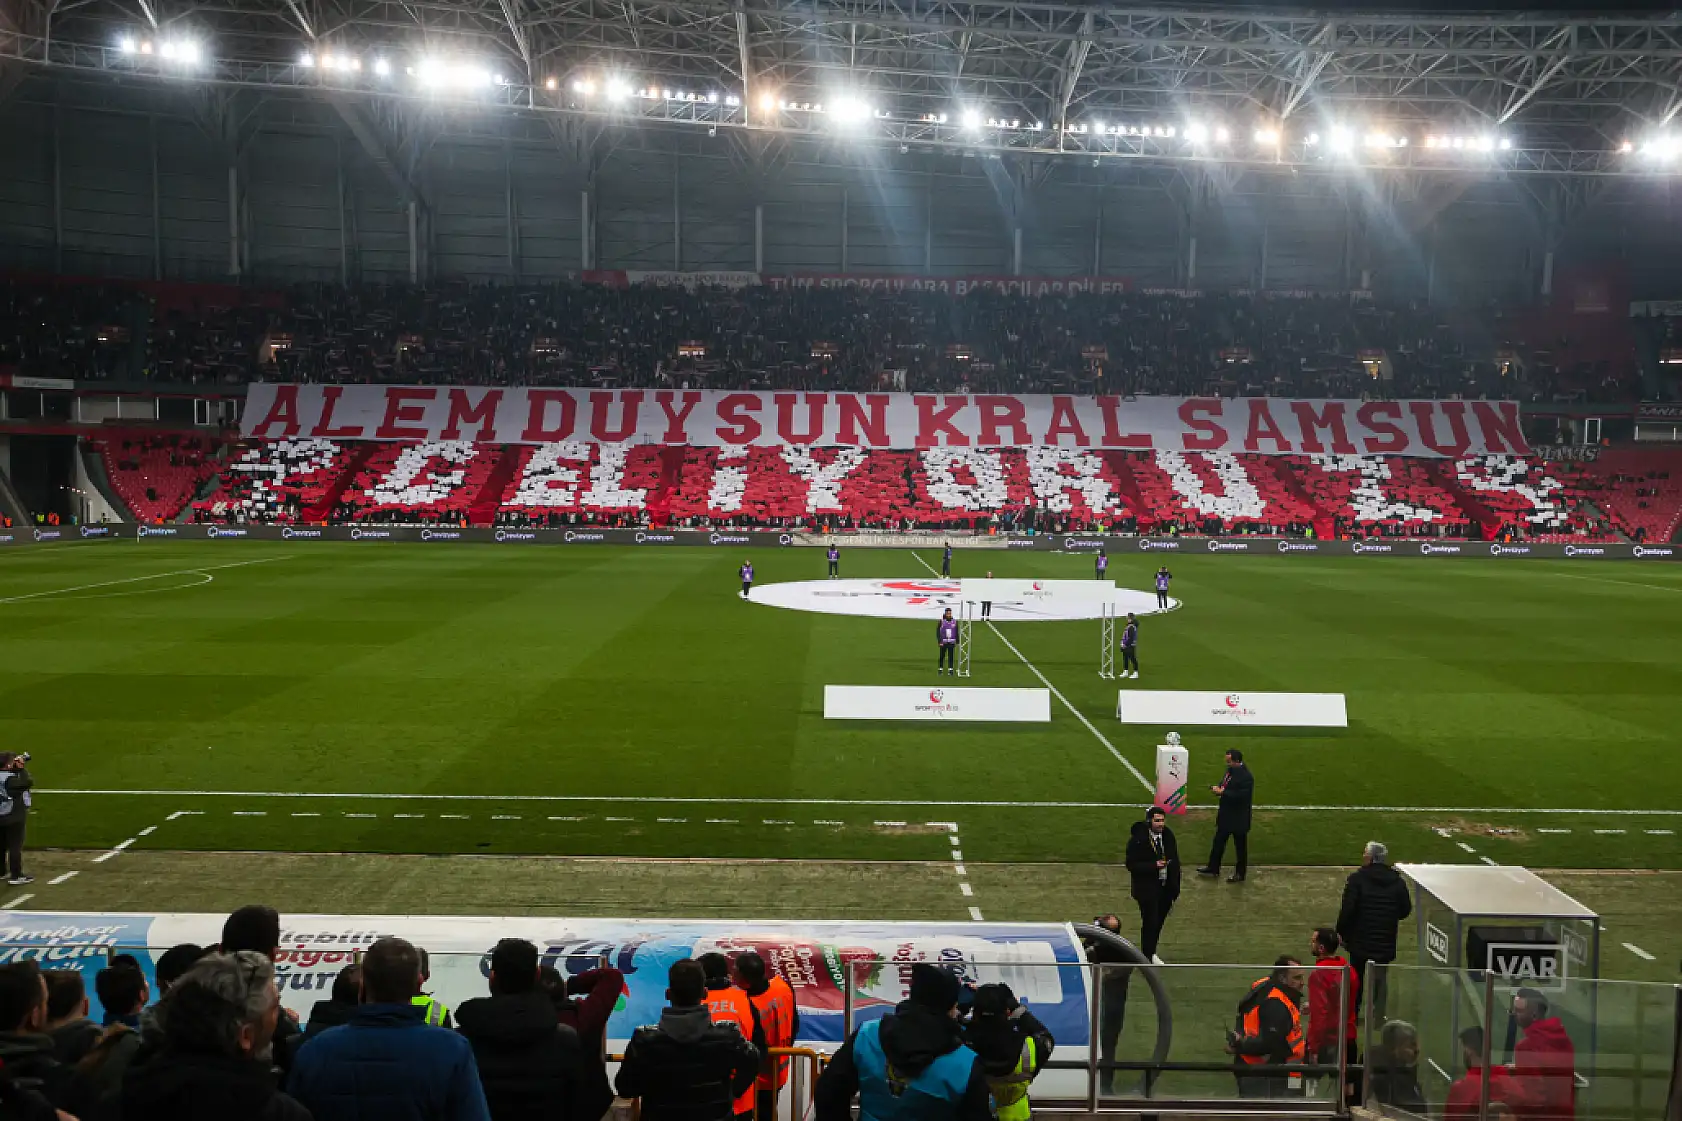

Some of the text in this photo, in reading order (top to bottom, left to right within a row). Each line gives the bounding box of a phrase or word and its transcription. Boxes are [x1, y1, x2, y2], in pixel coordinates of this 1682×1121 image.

[251, 385, 503, 441] ALEM
[914, 394, 1152, 446] KRAL
[1178, 399, 1534, 457] SAMSUN
[1429, 929, 1446, 952] VAR
[1497, 955, 1557, 980] VAR
[711, 1000, 737, 1013] ZEL
